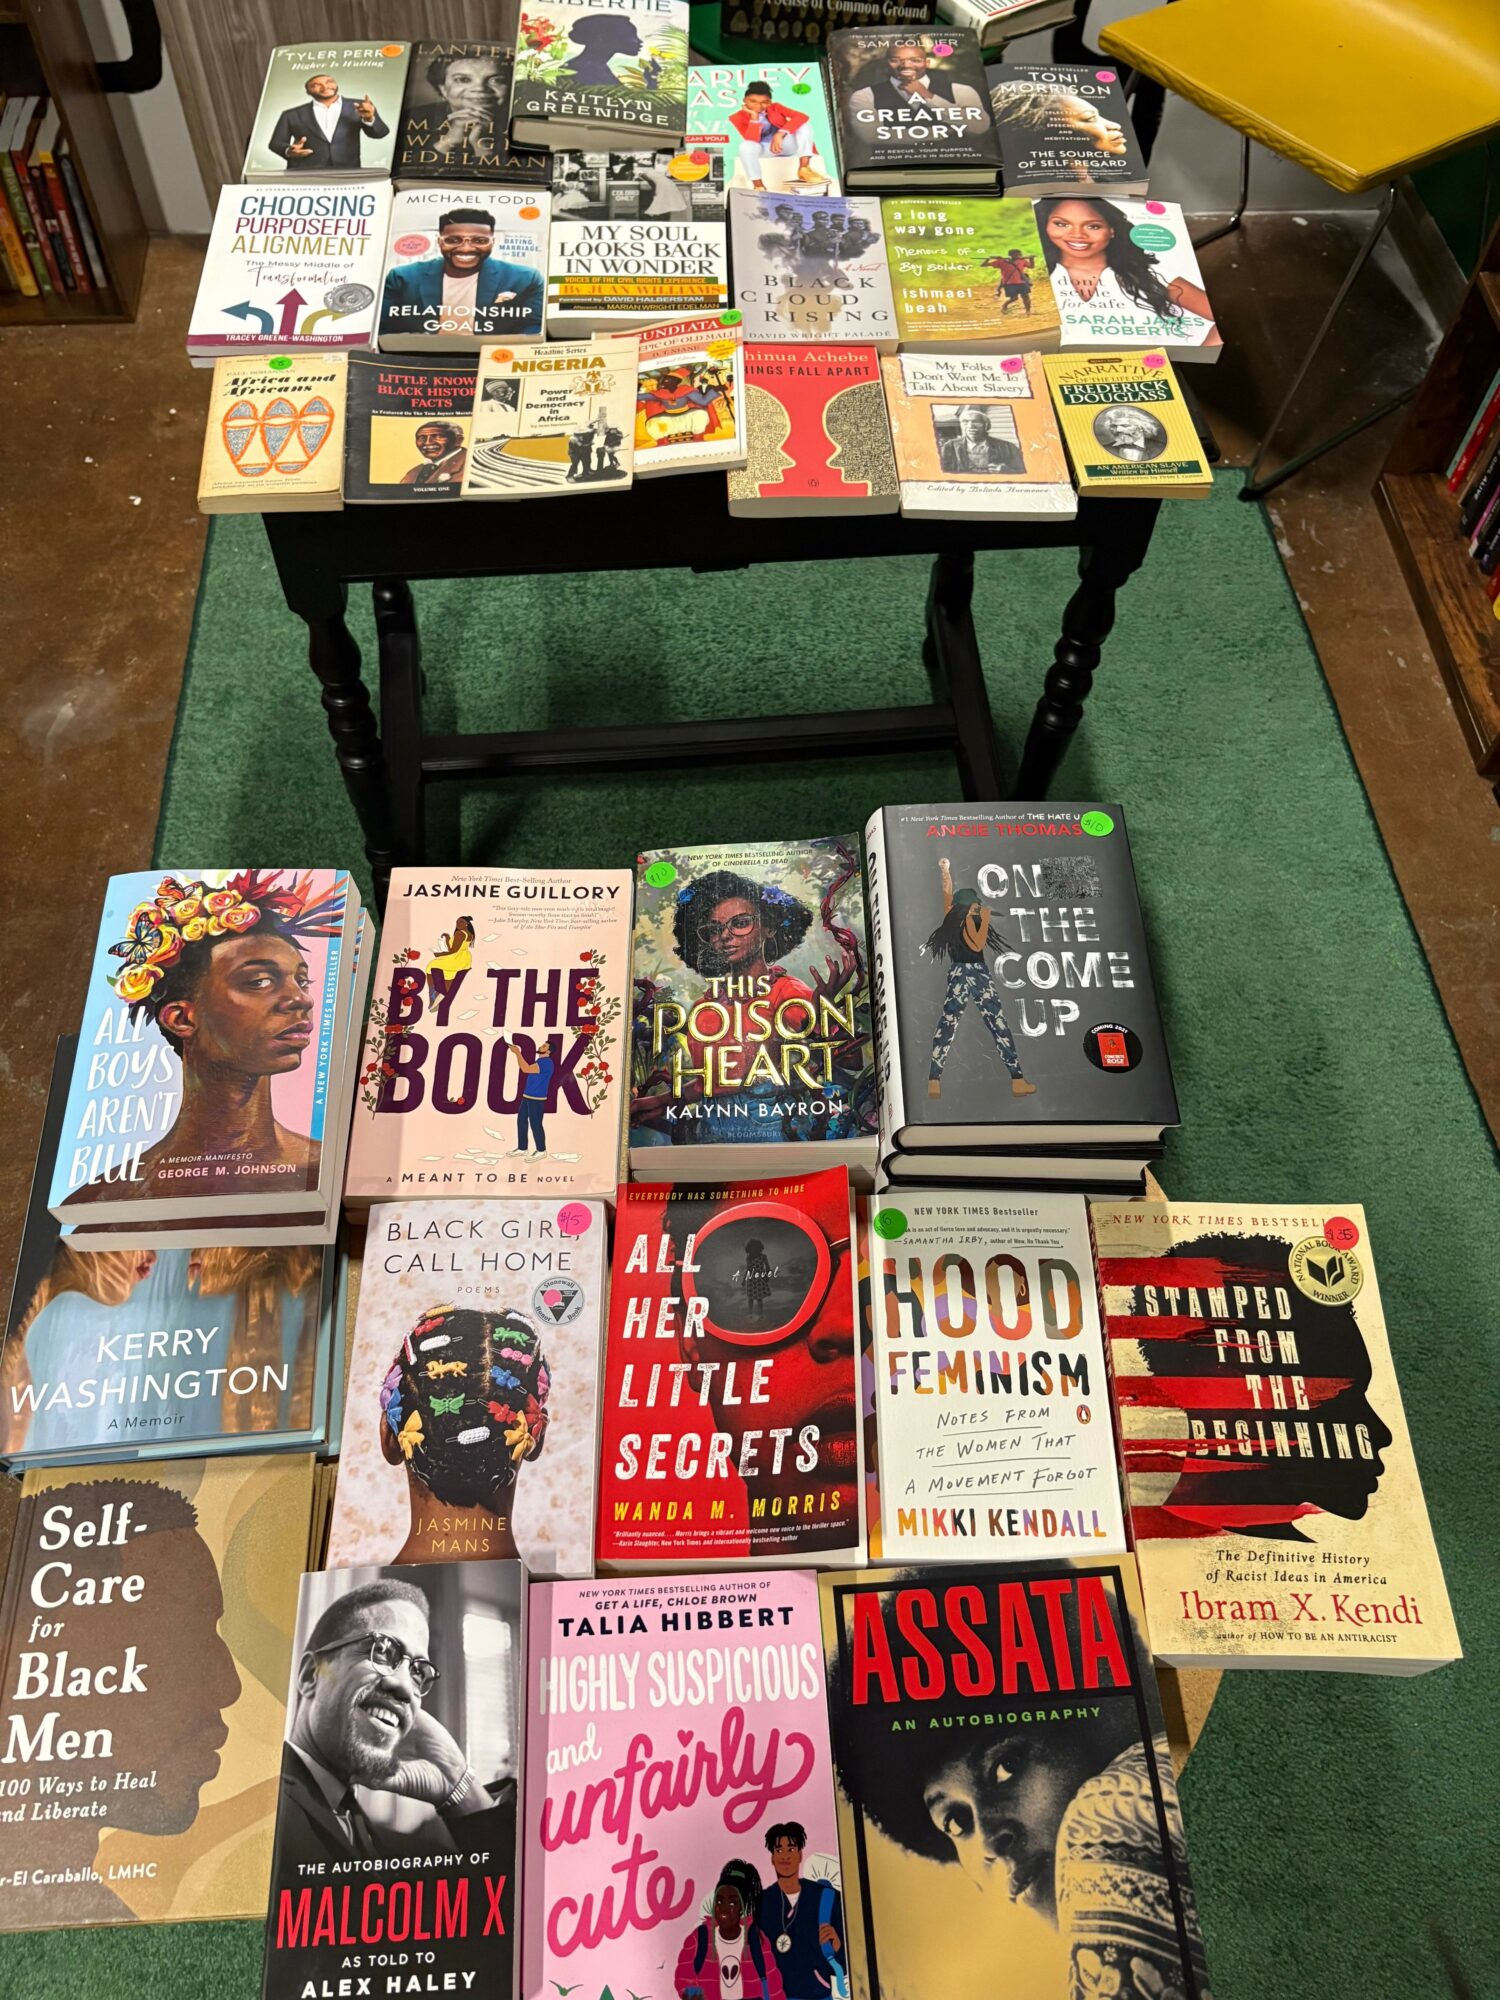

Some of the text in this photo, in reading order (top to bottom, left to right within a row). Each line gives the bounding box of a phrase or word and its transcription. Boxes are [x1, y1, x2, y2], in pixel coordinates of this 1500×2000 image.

[857, 39, 959, 48] SAM COLLIER
[286, 50, 384, 61] TYLER PERR
[1028, 72, 1078, 83] TONI
[908, 92, 926, 104] A
[1001, 83, 1111, 95] MORRISON
[545, 90, 652, 111] KAITLYN
[526, 101, 669, 125] GREENIDGE
[856, 108, 982, 123] GREATER
[876, 125, 968, 139] STORY
[402, 151, 546, 168] EDELMAN
[1018, 159, 1126, 169] OF SELF-REGARD
[240, 195, 376, 216] CHOOSING
[406, 194, 536, 205] MICHAEL TODD
[235, 217, 372, 236] PURPOSEFUL
[894, 210, 948, 222] a long
[582, 226, 697, 241] MY SOUL
[895, 225, 975, 236] way gone
[231, 235, 370, 256] ALIGNMENT
[559, 242, 721, 258] LOOKS BACK
[248, 265, 348, 287] Transformation
[565, 259, 715, 274] IN WONDER
[764, 275, 876, 288] BLACK
[1057, 276, 1106, 287] don't
[740, 291, 859, 305] CLOUD
[902, 288, 972, 298] ishmael
[389, 305, 533, 317] RELATIONSHIP
[904, 303, 948, 313] beah
[1061, 298, 1126, 310] for safe
[423, 320, 494, 332] GOALS
[764, 311, 888, 322] RISING
[226, 334, 255, 342] TRACEY
[635, 320, 719, 342] SUNDIATA
[511, 357, 606, 373] NIGERIA
[936, 362, 993, 371] My Folks
[1059, 364, 1164, 382] NARRATIVE
[224, 374, 336, 387] Africa and
[379, 374, 477, 385] LITTLE KNOW
[909, 382, 1024, 394] Talk About Slavery
[1062, 380, 1168, 394] FREDERICK
[411, 399, 452, 408] FACTS
[526, 401, 585, 409] Democracy
[1069, 391, 1167, 403] DOUGLASS
[927, 824, 1084, 837] ANGIE THOMAS
[403, 884, 620, 899] JASMINE GUILLORY
[1010, 907, 1100, 942] THE
[994, 951, 1135, 989] COME
[388, 967, 600, 1027] BY THE
[705, 975, 772, 999] THIS
[93, 1005, 146, 1046] ALL
[652, 994, 856, 1056] POISON
[1015, 999, 1080, 1037] UP
[87, 1045, 175, 1092] BOYS
[376, 1032, 594, 1114] BOOK
[672, 1040, 848, 1099] HEART
[77, 1092, 177, 1139] AREN'T
[666, 1100, 844, 1120] KALYNN BAYRON
[68, 1141, 151, 1188] BLUE
[158, 1164, 297, 1179] GEORGE M. JOHNSON
[936, 1207, 959, 1215] YORK
[963, 1207, 989, 1215] TIMES
[993, 1207, 1038, 1216] Bestseller
[384, 1252, 572, 1273] CALL HOME
[625, 1234, 701, 1273] ALL
[457, 1286, 501, 1295] POEMS
[544, 1280, 575, 1289] Stonewall
[883, 1253, 1084, 1341] HOOD
[1144, 1285, 1292, 1320] STAMPED
[1313, 1290, 1350, 1302] WINNER
[622, 1297, 709, 1339] HER
[97, 1327, 220, 1363] KERRY
[1214, 1329, 1301, 1364] FROM
[618, 1359, 774, 1408] LITTLE
[888, 1351, 1090, 1397] FEMINISM
[11, 1364, 289, 1413] WASHINGTON
[1246, 1375, 1310, 1411] THE
[1188, 1420, 1375, 1460] BEGINNING
[615, 1425, 820, 1480] SECRETS
[614, 1491, 841, 1521] WANDA M. MORRIS
[39, 1501, 148, 1551] Self-
[416, 1516, 508, 1536] JASMINE
[897, 1508, 1106, 1538] MIKKI KENDALL
[431, 1539, 491, 1553] MANS
[30, 1561, 146, 1609] Care
[602, 1589, 626, 1597] YORK
[629, 1588, 656, 1596] TIMES
[658, 1585, 717, 1594] BESTSELLING
[719, 1583, 757, 1592] AUTHOR
[1180, 1590, 1424, 1627] Ibram X. Kendi
[559, 1607, 794, 1637] TALIA HIBBERT
[852, 1576, 1132, 1705] ASSATA
[12, 1645, 149, 1701] Black
[539, 1642, 820, 1716] HIGHLY SUSPICIOUS
[891, 1706, 1102, 1732] AN AUTOBIOGRAPHY
[1, 1712, 114, 1764] Men
[546, 1721, 603, 1776] and
[540, 1705, 816, 1853] unfairly
[298, 1852, 490, 1875] THE AUTOBIOGRAPHY OF
[546, 1833, 696, 1958] cute
[276, 1875, 507, 1950] MALCOLM X
[301, 1971, 476, 1999] ALEX HALEY
